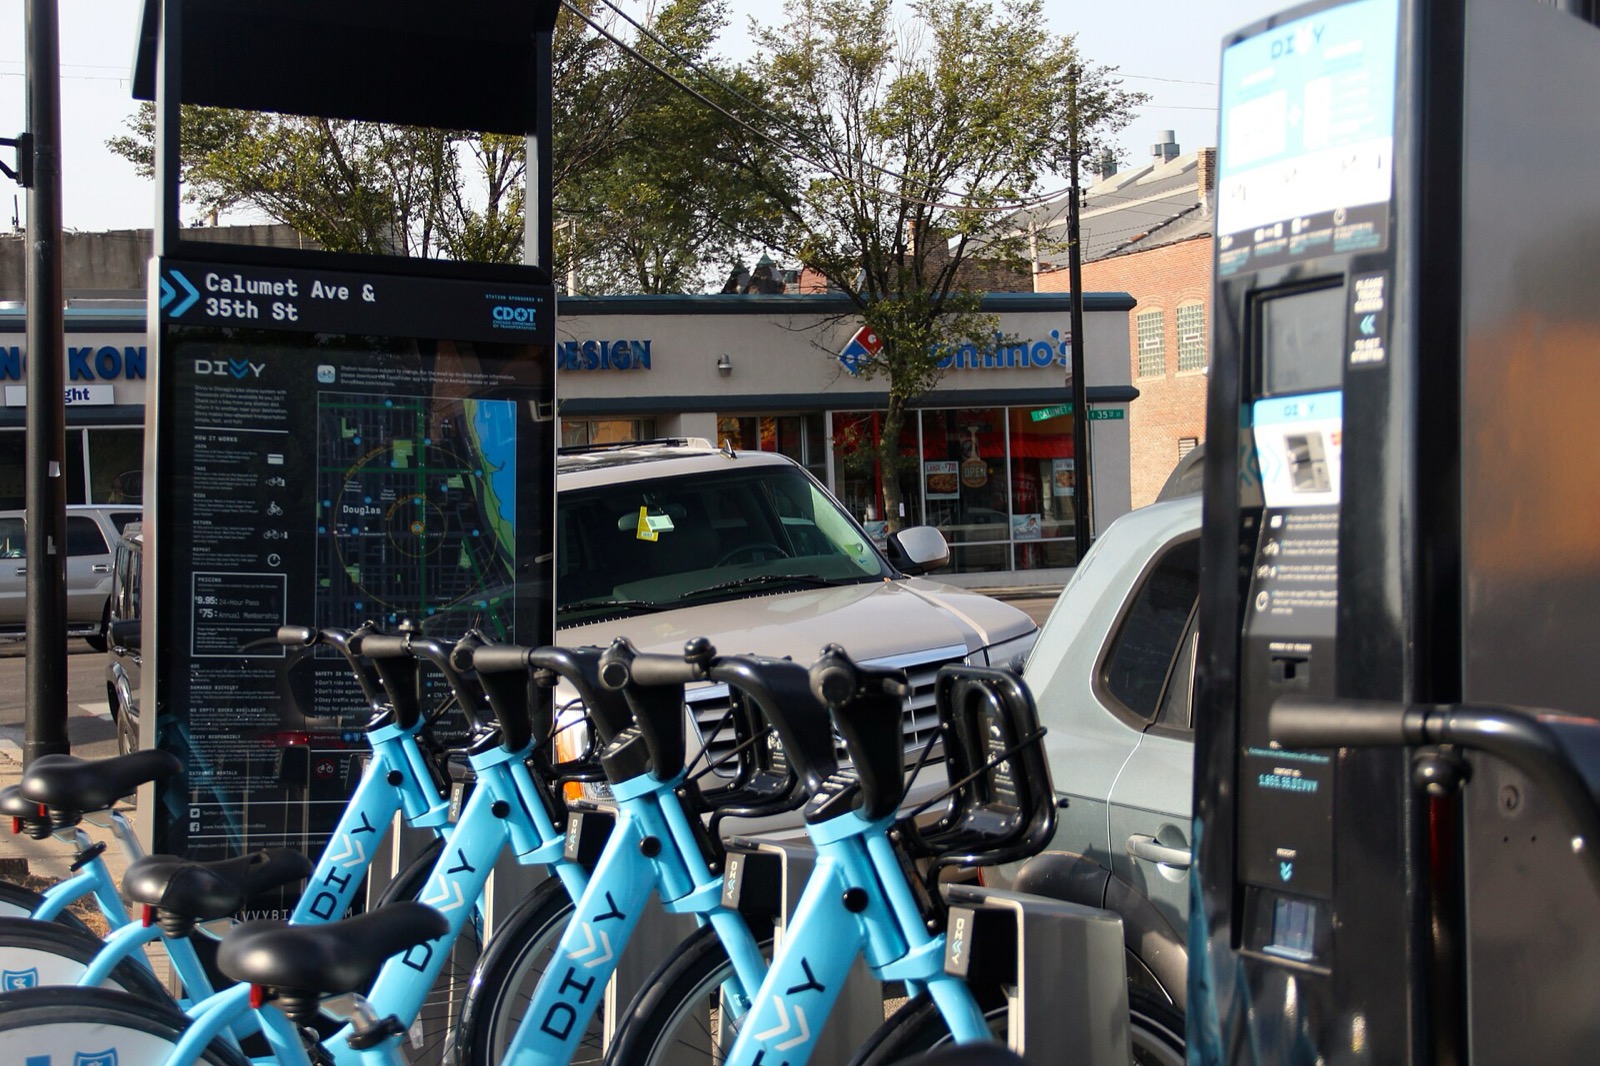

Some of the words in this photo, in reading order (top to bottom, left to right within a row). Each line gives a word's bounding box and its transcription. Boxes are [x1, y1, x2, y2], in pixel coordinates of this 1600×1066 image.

[206, 272, 298, 297] Calumet
[311, 280, 349, 301] Ave
[362, 284, 376, 302] &
[206, 298, 258, 320] 35th
[273, 302, 298, 321] St
[493, 306, 536, 322] CDOT
[927, 329, 1067, 368] omino's
[1038, 406, 1068, 419] CALUMET
[964, 467, 986, 478] OPEN
[343, 505, 381, 516] Douglas
[402, 848, 476, 973] DVVY
